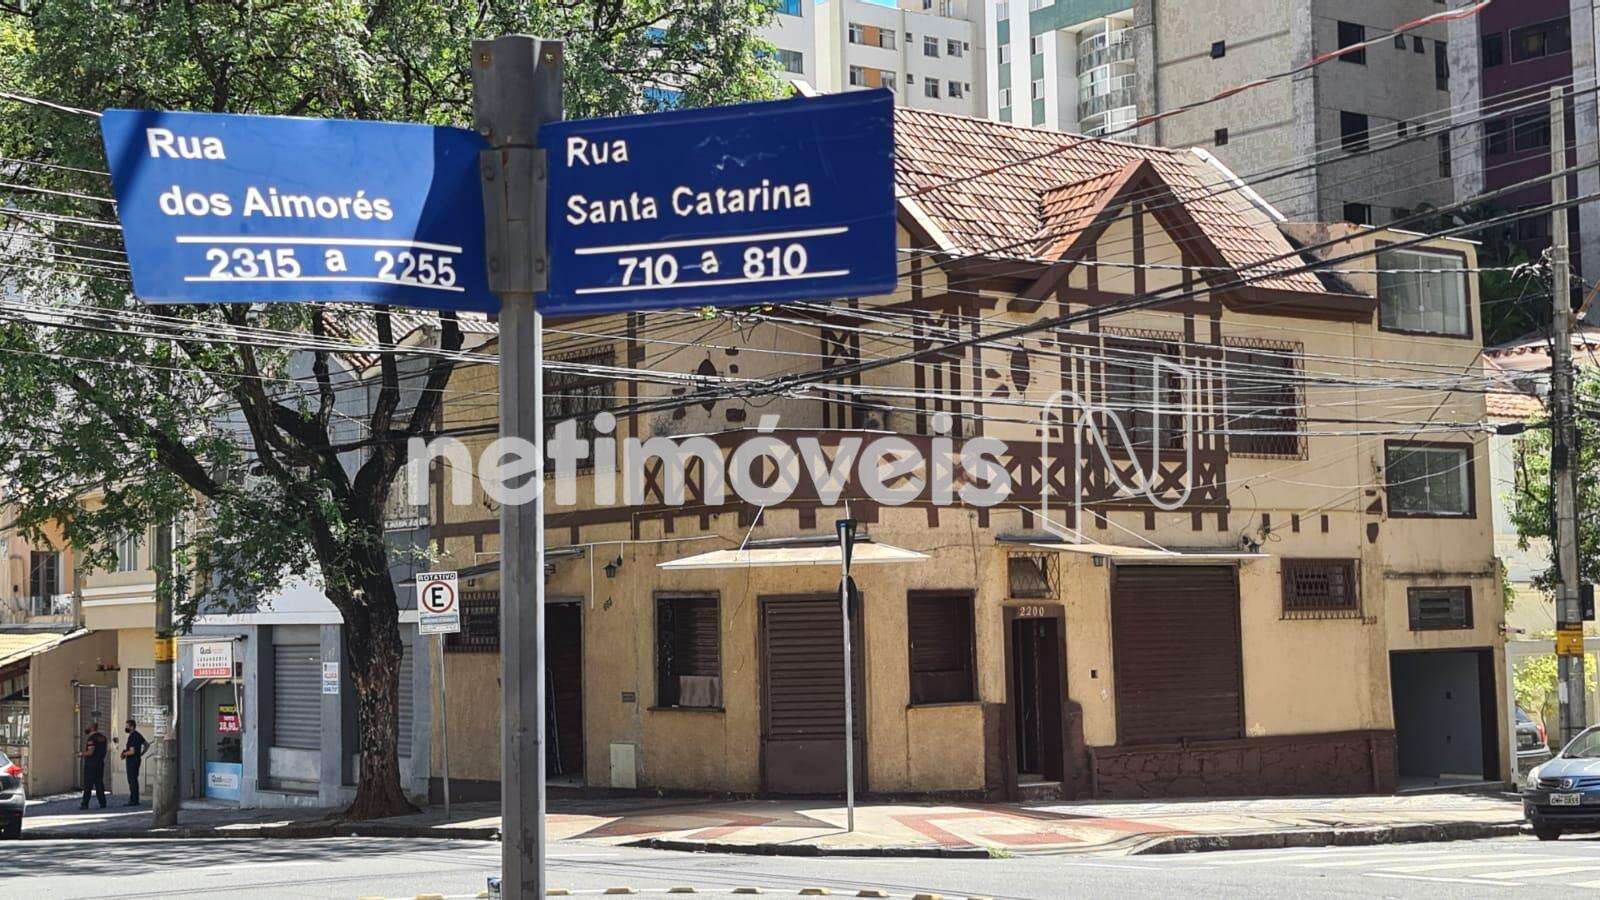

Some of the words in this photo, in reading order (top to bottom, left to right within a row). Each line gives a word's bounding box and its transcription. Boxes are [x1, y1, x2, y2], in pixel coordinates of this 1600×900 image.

[146, 128, 226, 160] Rua
[566, 137, 629, 167] Rua
[159, 186, 232, 216] dos
[243, 187, 394, 221] Aimorés
[566, 192, 658, 226] Santa
[671, 179, 812, 217] Catarina
[206, 247, 301, 279] 2315
[325, 248, 347, 272] a
[374, 251, 456, 286] 2255
[618, 254, 679, 287] 710
[701, 250, 720, 275] a
[743, 243, 808, 280] 810
[431, 587, 444, 607] E
[1019, 606, 1045, 617] 2200
